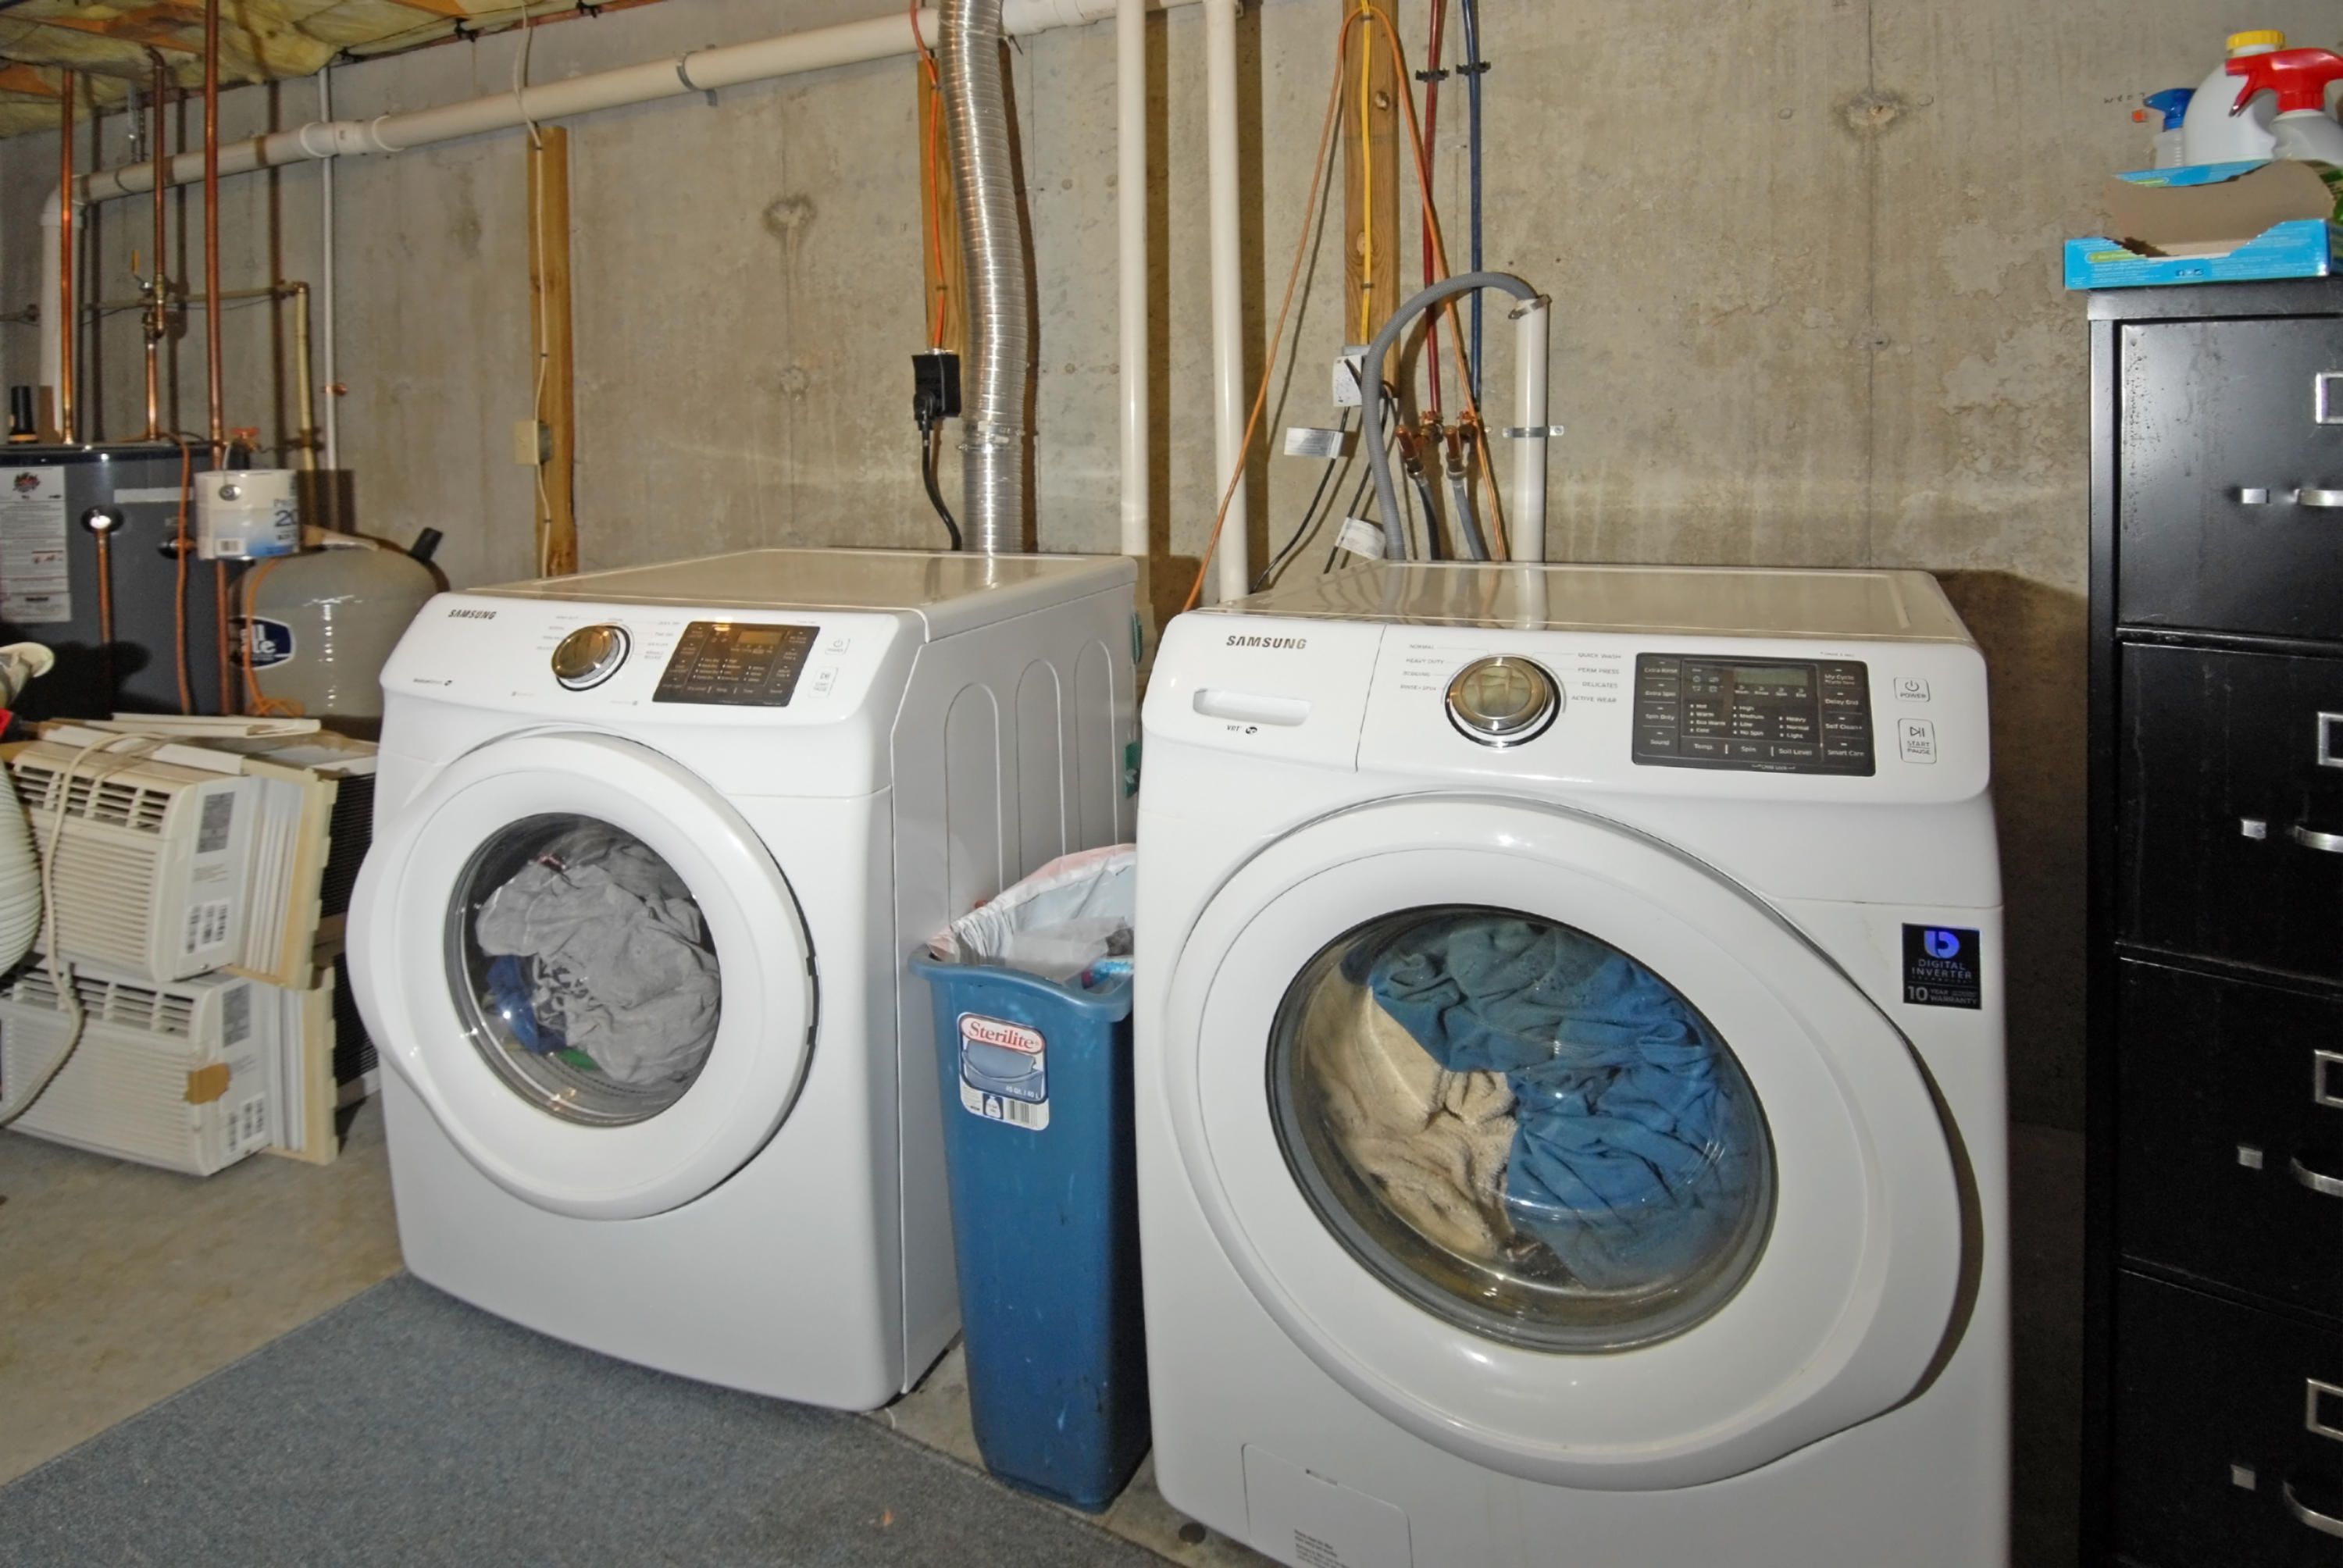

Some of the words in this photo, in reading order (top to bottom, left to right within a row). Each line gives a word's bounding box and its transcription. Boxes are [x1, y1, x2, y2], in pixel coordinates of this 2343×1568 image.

[448, 609, 497, 619] SAMSUNG
[1225, 635, 1307, 650] SAMSUNG
[1778, 747, 1792, 756] Soil
[1827, 749, 1848, 757] Smart
[1917, 958, 1967, 971] DIGITAL
[1911, 967, 1973, 980] INVERTER
[1906, 985, 1929, 1002] 10
[1930, 994, 1977, 1005] WARRANTY
[968, 1021, 1036, 1049] Sterilite
